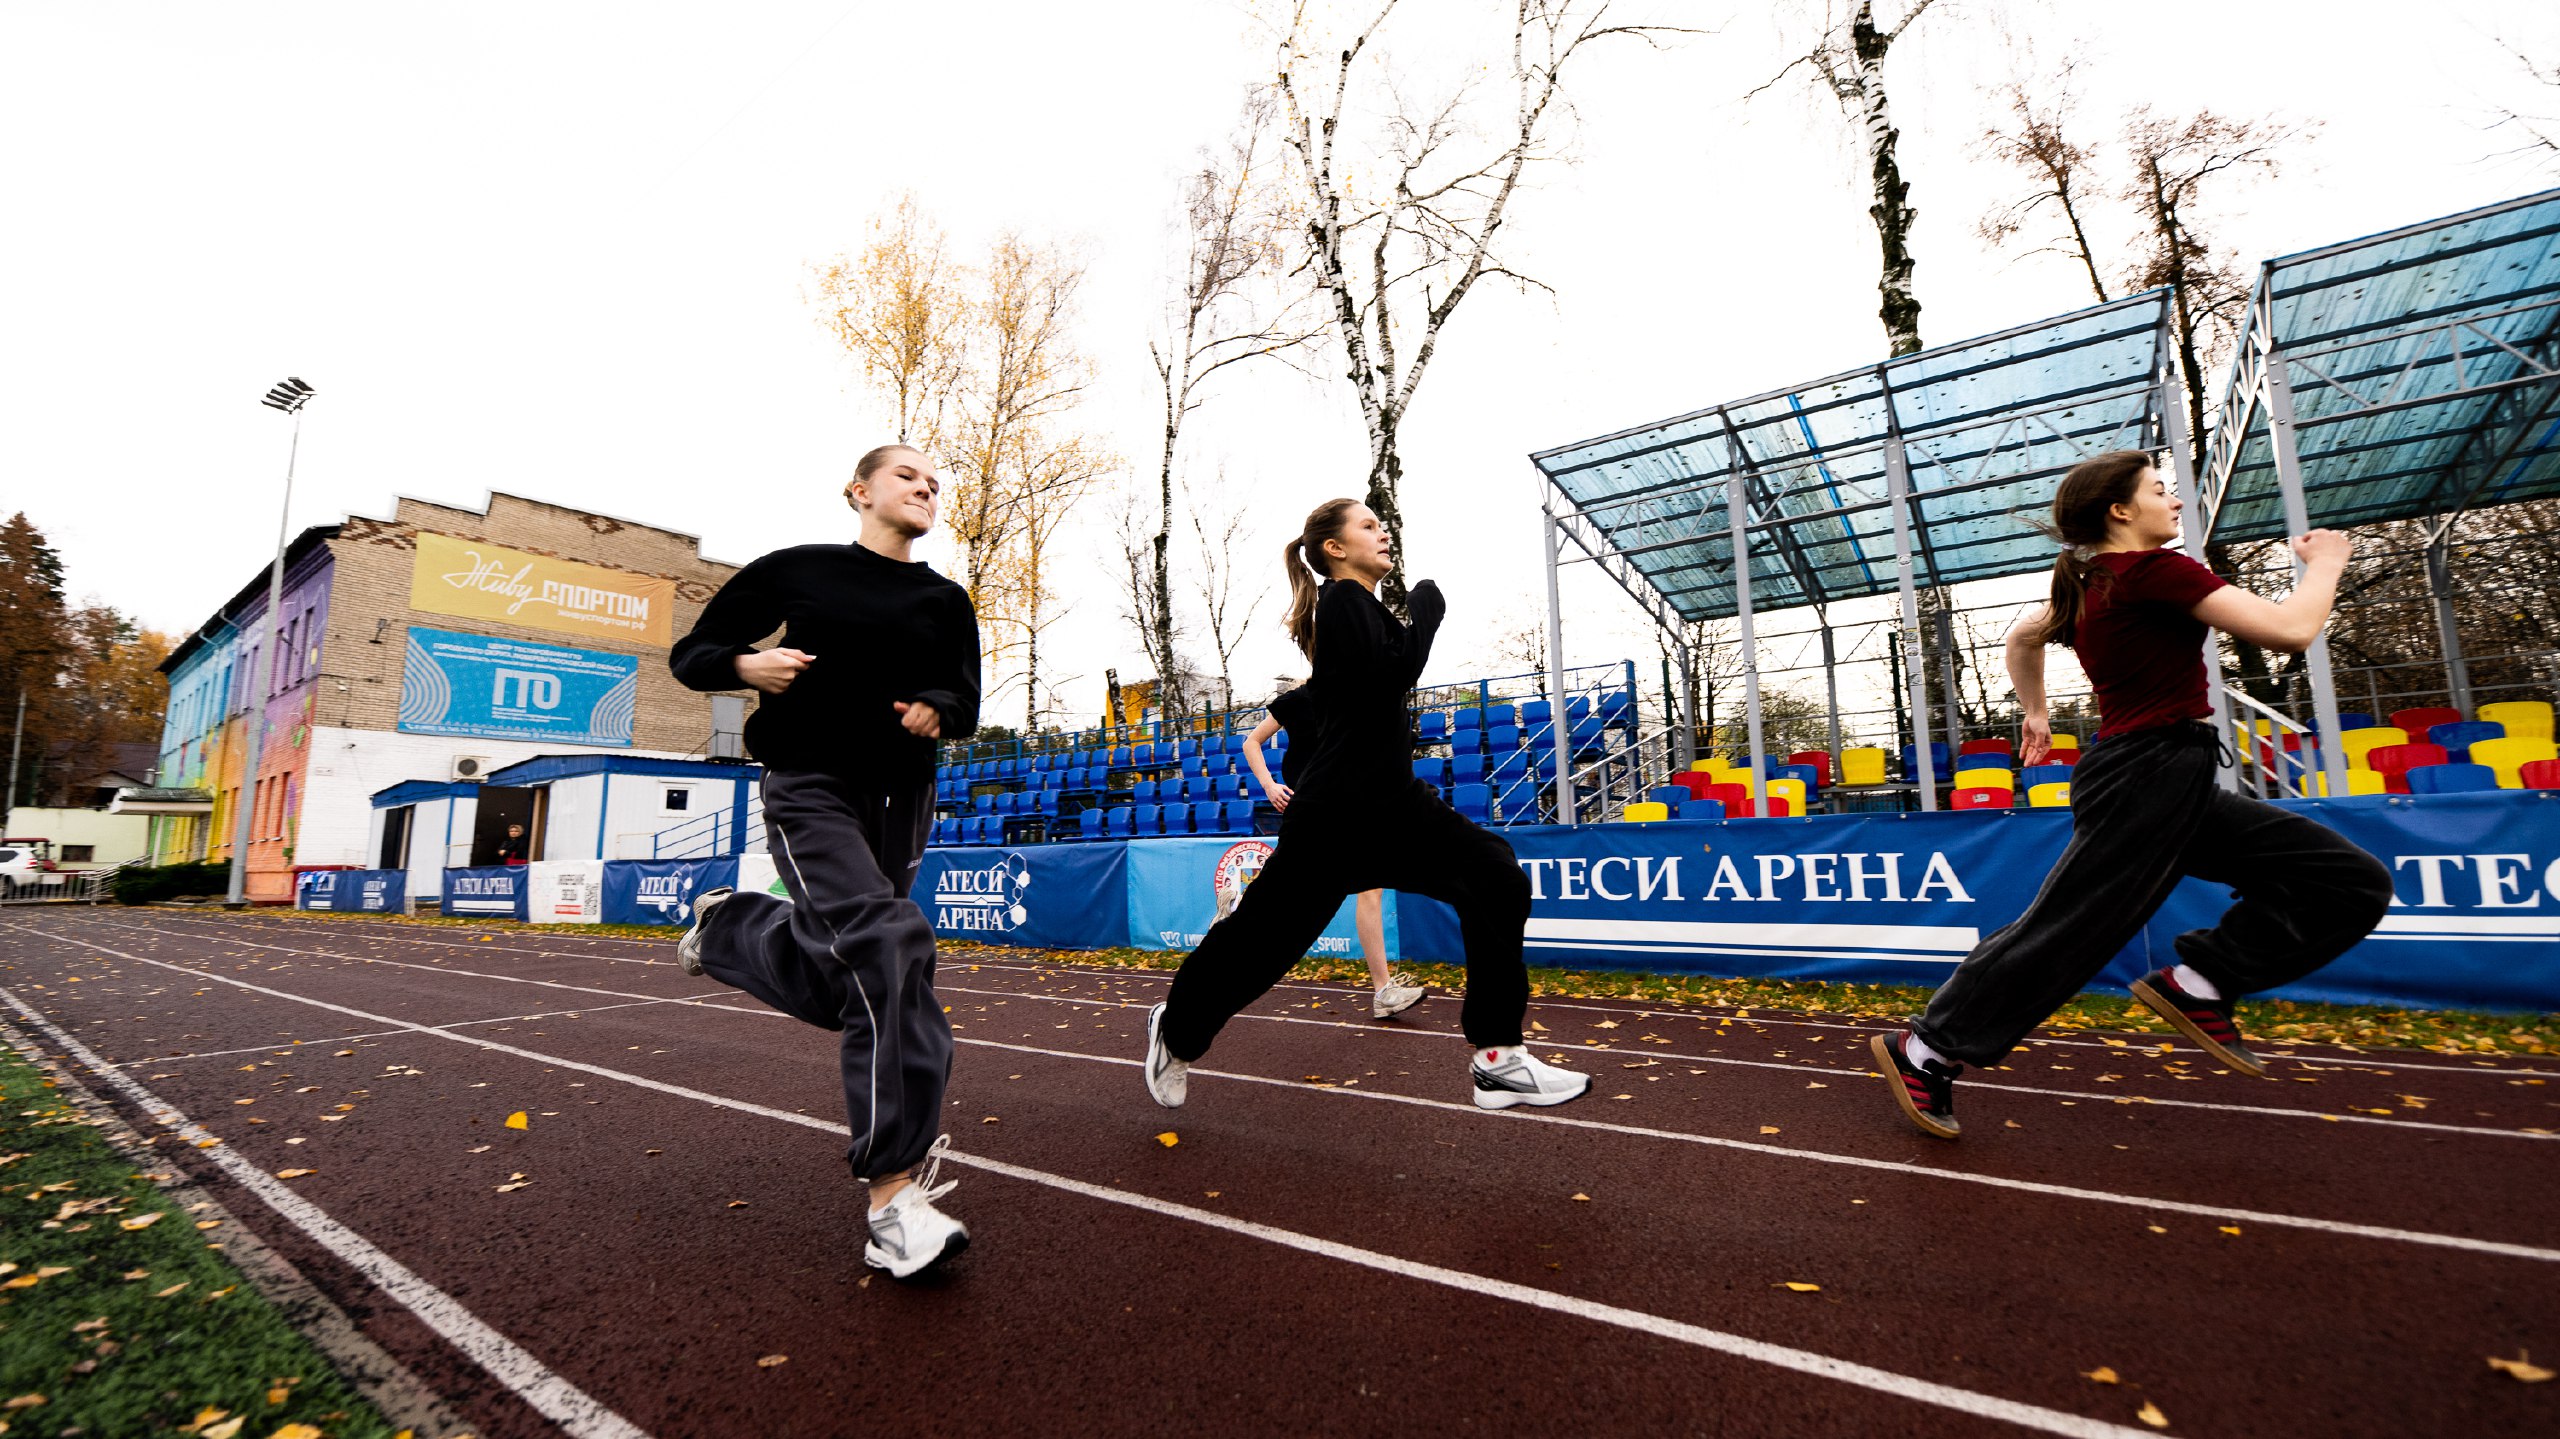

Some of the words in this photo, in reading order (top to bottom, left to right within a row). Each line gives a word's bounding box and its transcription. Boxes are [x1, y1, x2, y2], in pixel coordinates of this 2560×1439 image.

[441, 551, 534, 615] Живу
[542, 579, 650, 620] СПОРТОМ
[492, 667, 562, 710] ГТО
[637, 876, 679, 895] АТЕСИ
[935, 870, 1004, 892] АТЕСИ
[1517, 856, 1685, 901] ТЕСИ
[1702, 851, 1976, 902] АРЕНА
[2389, 853, 2560, 908] ТЕ
[935, 907, 1005, 930] АРЕНА
